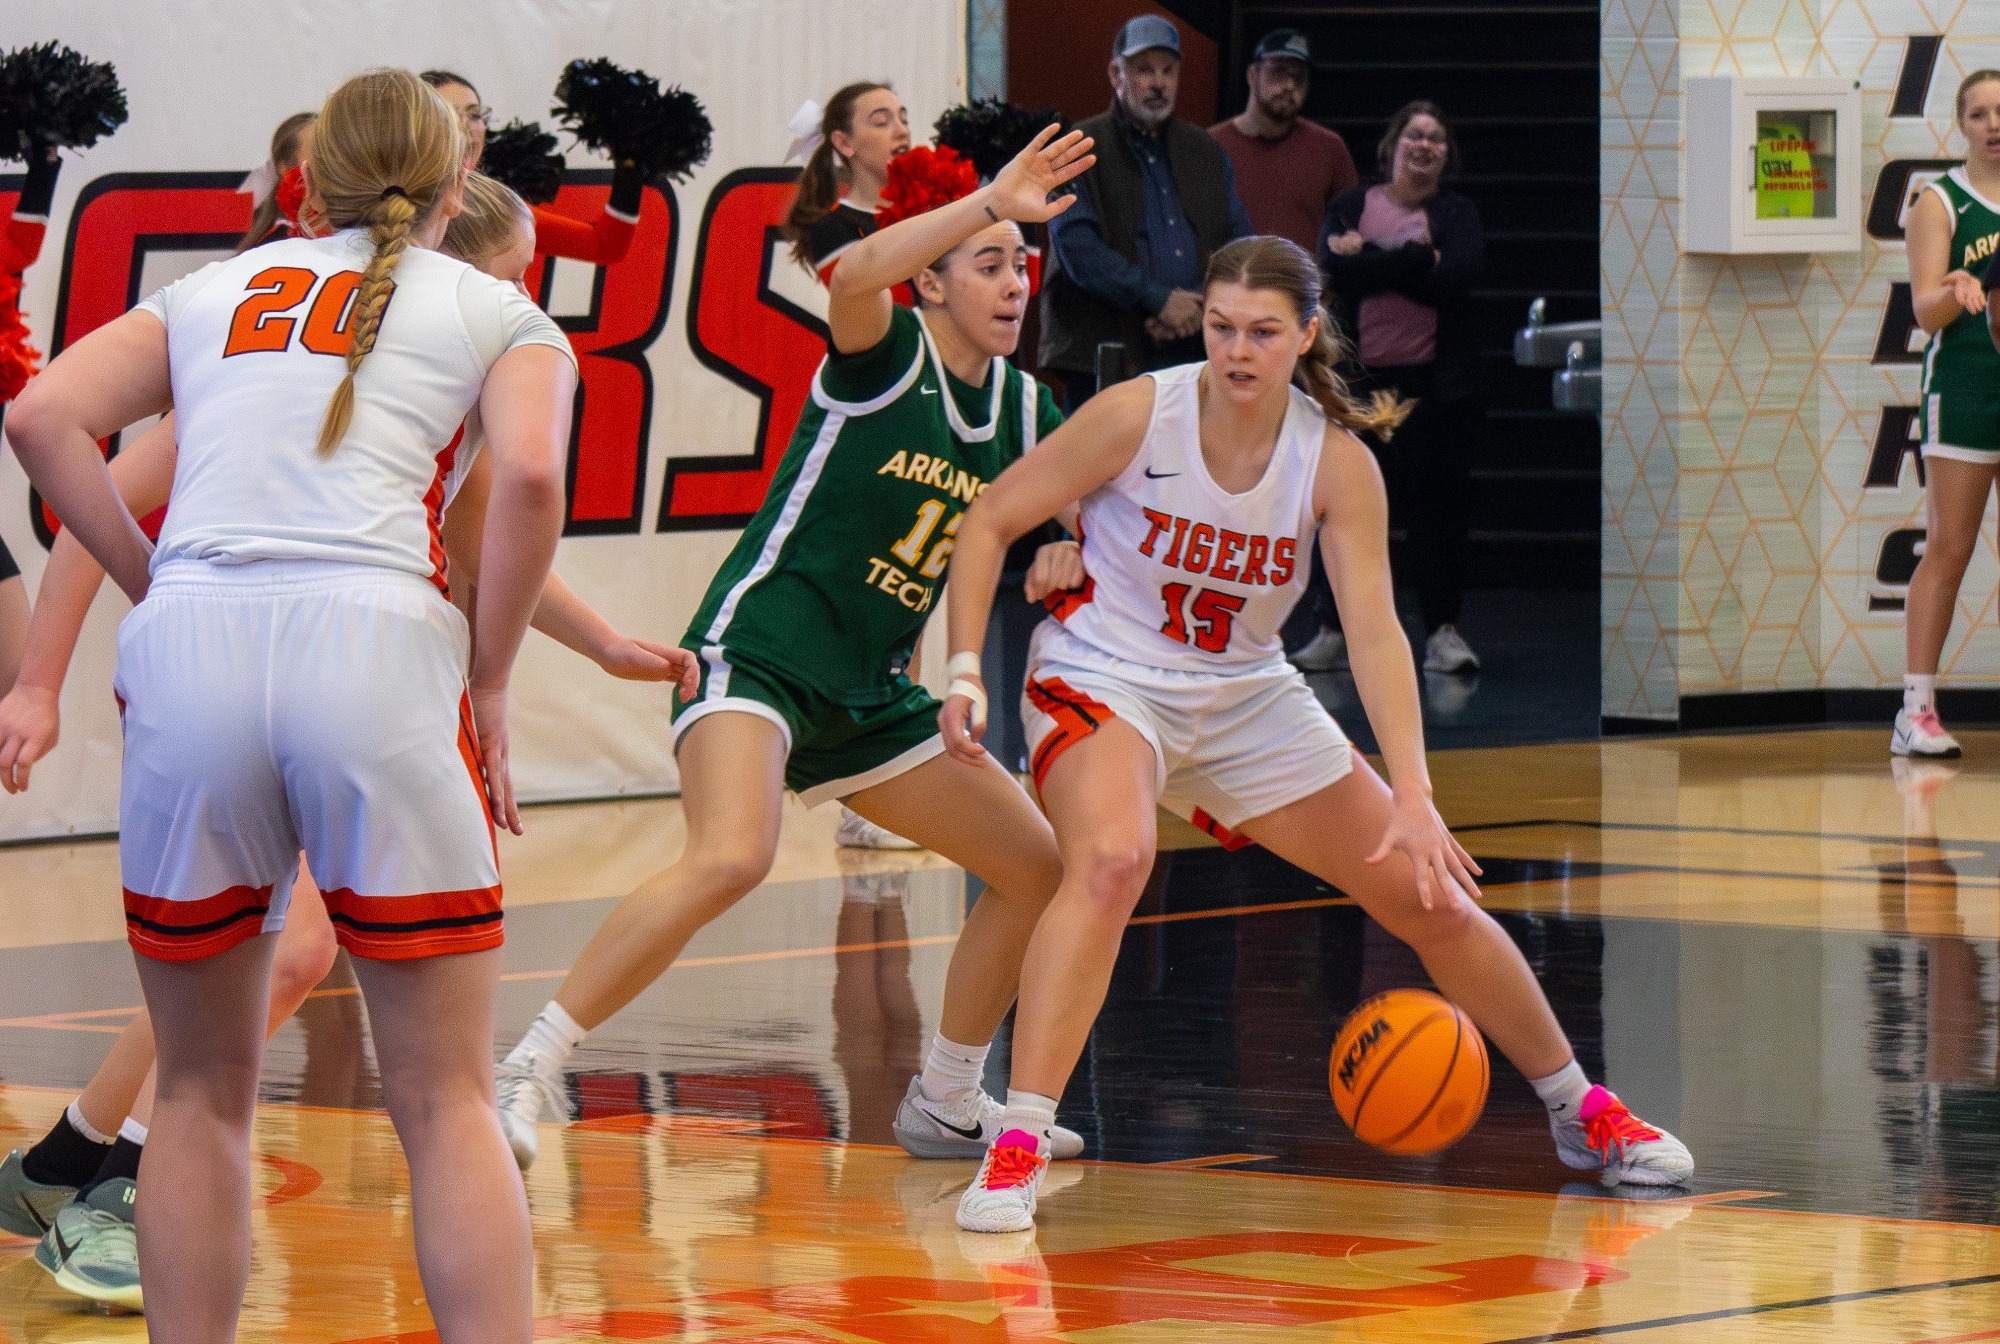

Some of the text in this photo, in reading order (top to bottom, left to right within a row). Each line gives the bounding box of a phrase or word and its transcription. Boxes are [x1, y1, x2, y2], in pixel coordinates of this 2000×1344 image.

[222, 266, 398, 359] 20
[1138, 505, 1298, 587] TIGERS
[1159, 581, 1248, 653] 15
[1337, 1016, 1392, 1092] NCAA
